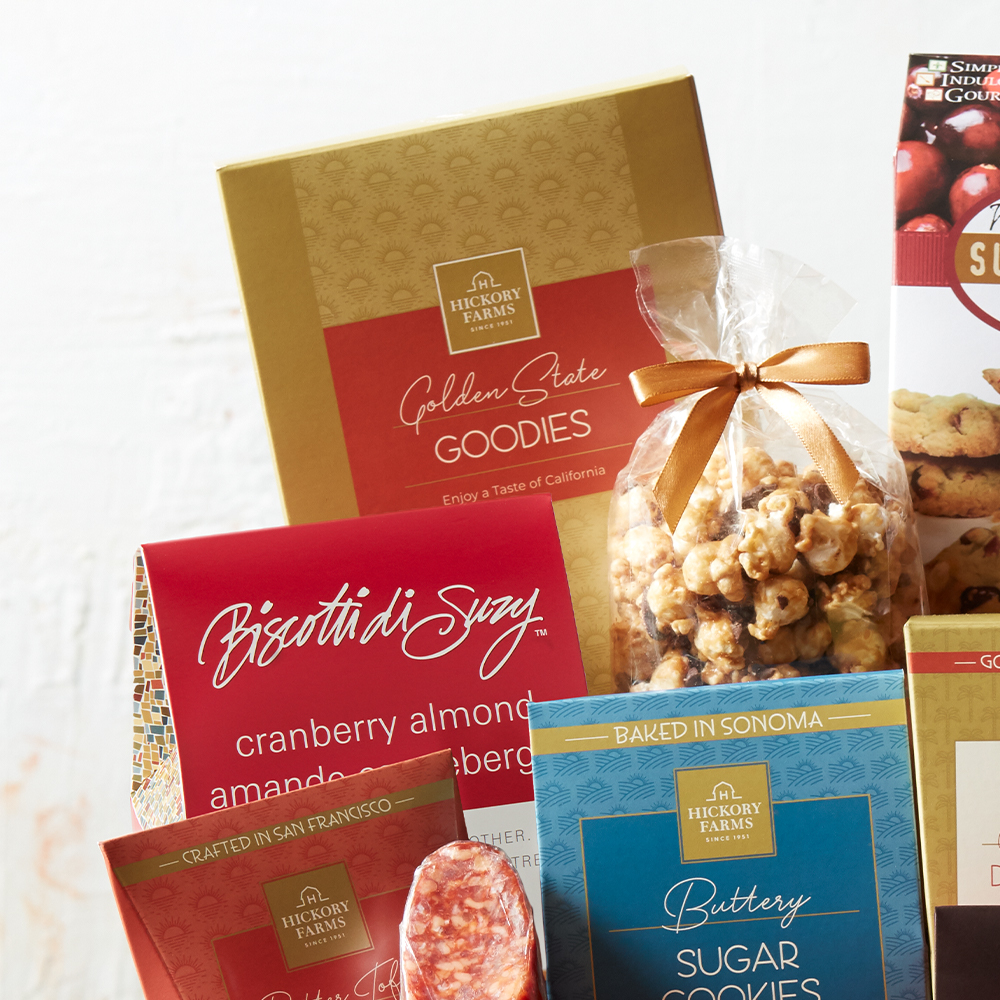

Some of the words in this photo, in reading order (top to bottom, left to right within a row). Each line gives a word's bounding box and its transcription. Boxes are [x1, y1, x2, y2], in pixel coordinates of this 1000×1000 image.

[450, 287, 521, 312] HICKORY
[463, 303, 516, 324] FARMS
[470, 323, 494, 333] SINCE
[497, 319, 513, 328] 1951
[400, 372, 511, 435] Golden
[512, 351, 607, 408] State
[434, 409, 592, 464] GOODIES
[442, 491, 479, 507] Enjoy
[482, 490, 490, 499] a
[492, 481, 527, 497] Taste
[529, 476, 543, 491] of
[544, 464, 607, 487] California
[198, 582, 370, 689] Biscotti
[360, 587, 416, 646] di
[402, 585, 543, 680] Suzy
[236, 710, 398, 758] cranberry
[410, 690, 533, 734] almond
[614, 721, 688, 745] BAKED
[694, 719, 716, 738] IN
[720, 711, 824, 736] SONOMA
[687, 801, 762, 821] HICKORY
[699, 817, 754, 835] FARMS
[182, 835, 251, 865] CRAFTED
[254, 830, 272, 846] IN
[273, 821, 306, 842] SAN
[308, 798, 392, 832] FRANCISCO
[281, 900, 350, 929] HICKORY
[661, 877, 812, 934] Buttery
[296, 916, 347, 940] FARMS
[677, 940, 800, 978] SUGAR
